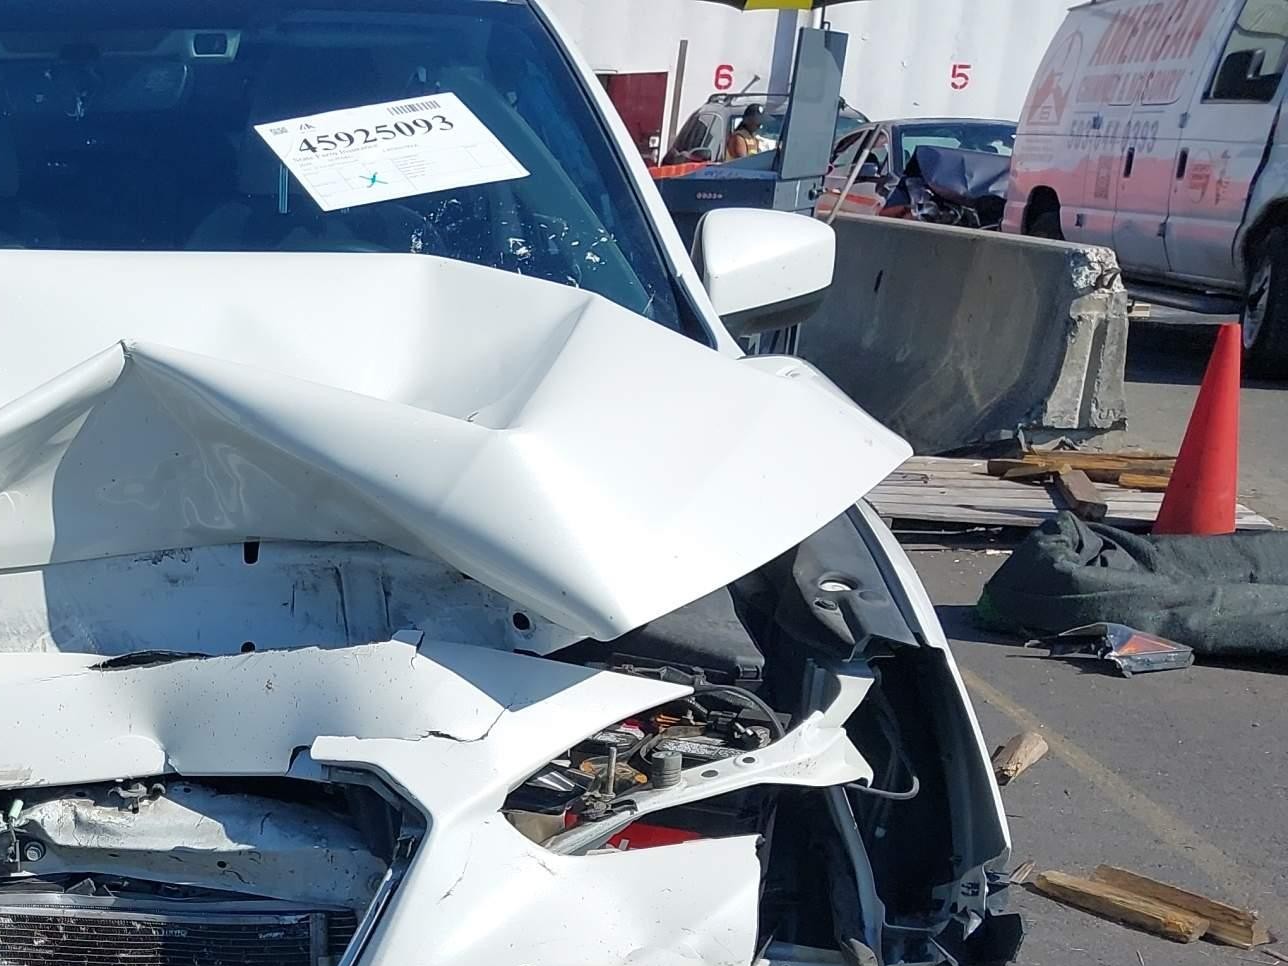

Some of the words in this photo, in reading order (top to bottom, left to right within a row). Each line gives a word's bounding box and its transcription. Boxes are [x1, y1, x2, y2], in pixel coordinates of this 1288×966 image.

[713, 64, 734, 90] 6
[950, 64, 971, 90] 5
[299, 115, 454, 153] 45925093
